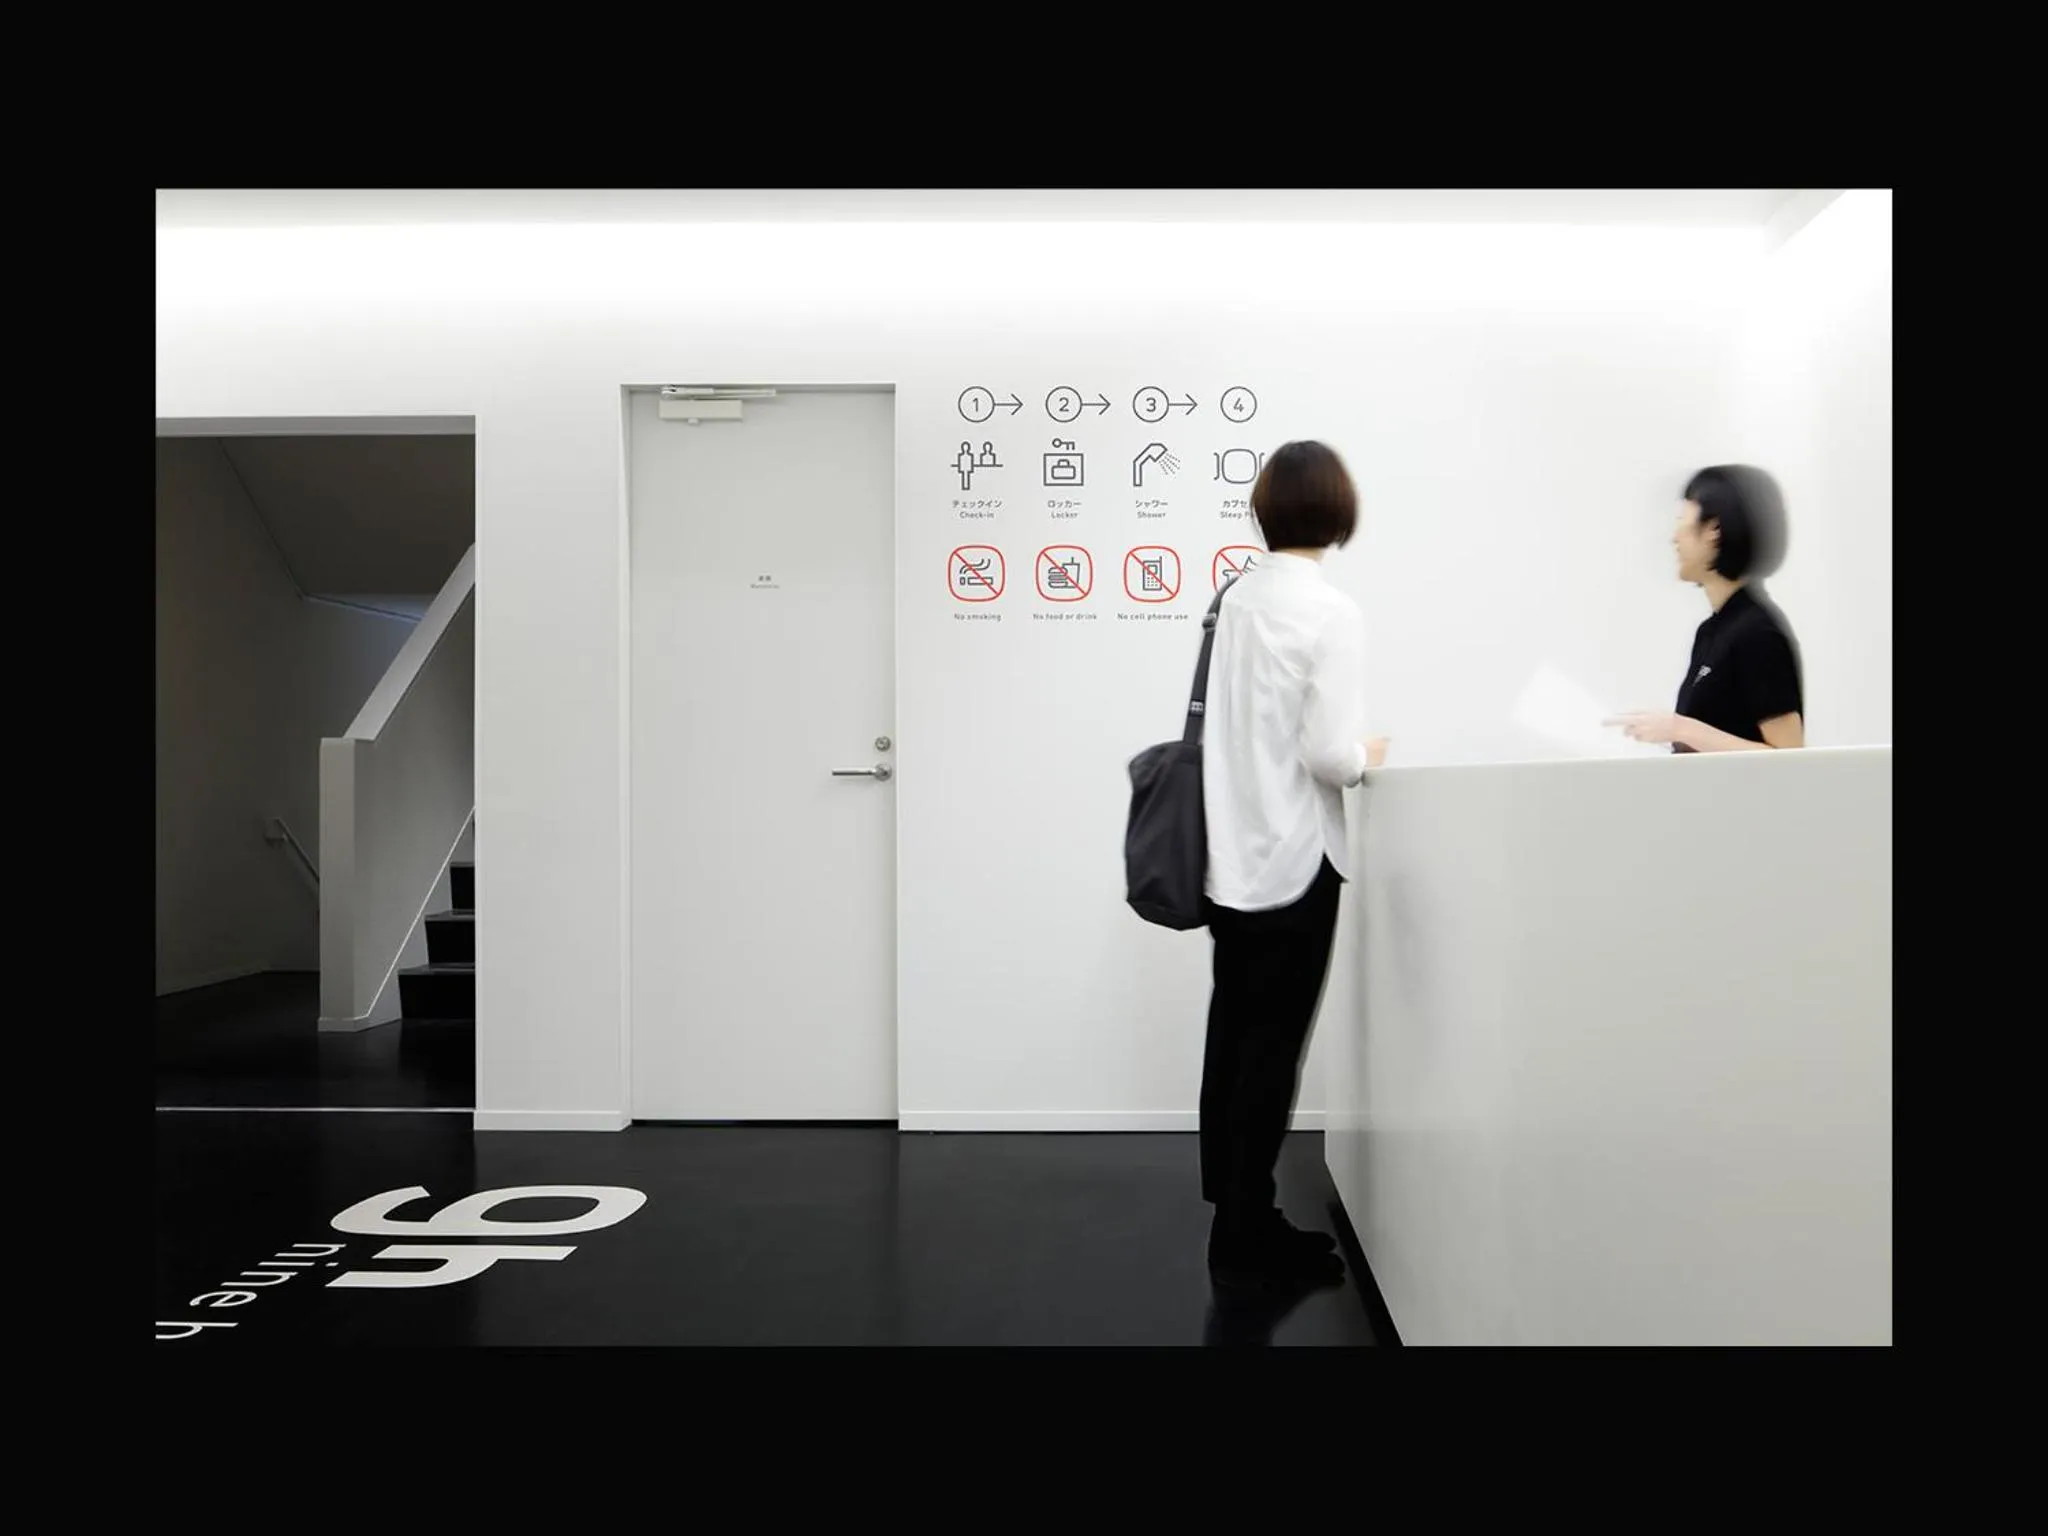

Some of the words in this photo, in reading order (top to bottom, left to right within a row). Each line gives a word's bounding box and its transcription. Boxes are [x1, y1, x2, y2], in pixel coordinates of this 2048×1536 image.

[972, 397, 980, 412] 1
[1058, 397, 1070, 412] 2
[1145, 397, 1157, 412] 3
[1232, 397, 1245, 412] 4
[951, 499, 1003, 509] チェックイン
[1047, 499, 1082, 509] ロッカー
[1135, 499, 1169, 508] シャワー
[1222, 499, 1248, 509] カプセ
[959, 511, 995, 519] Check-in
[1050, 511, 1079, 519] Locker
[1136, 511, 1166, 519] Shower
[1219, 511, 1243, 520] Sleep
[967, 613, 1001, 622] smoking
[1147, 613, 1172, 621] phone
[325, 1185, 647, 1288] 9h
[190, 1243, 347, 1308] nine
